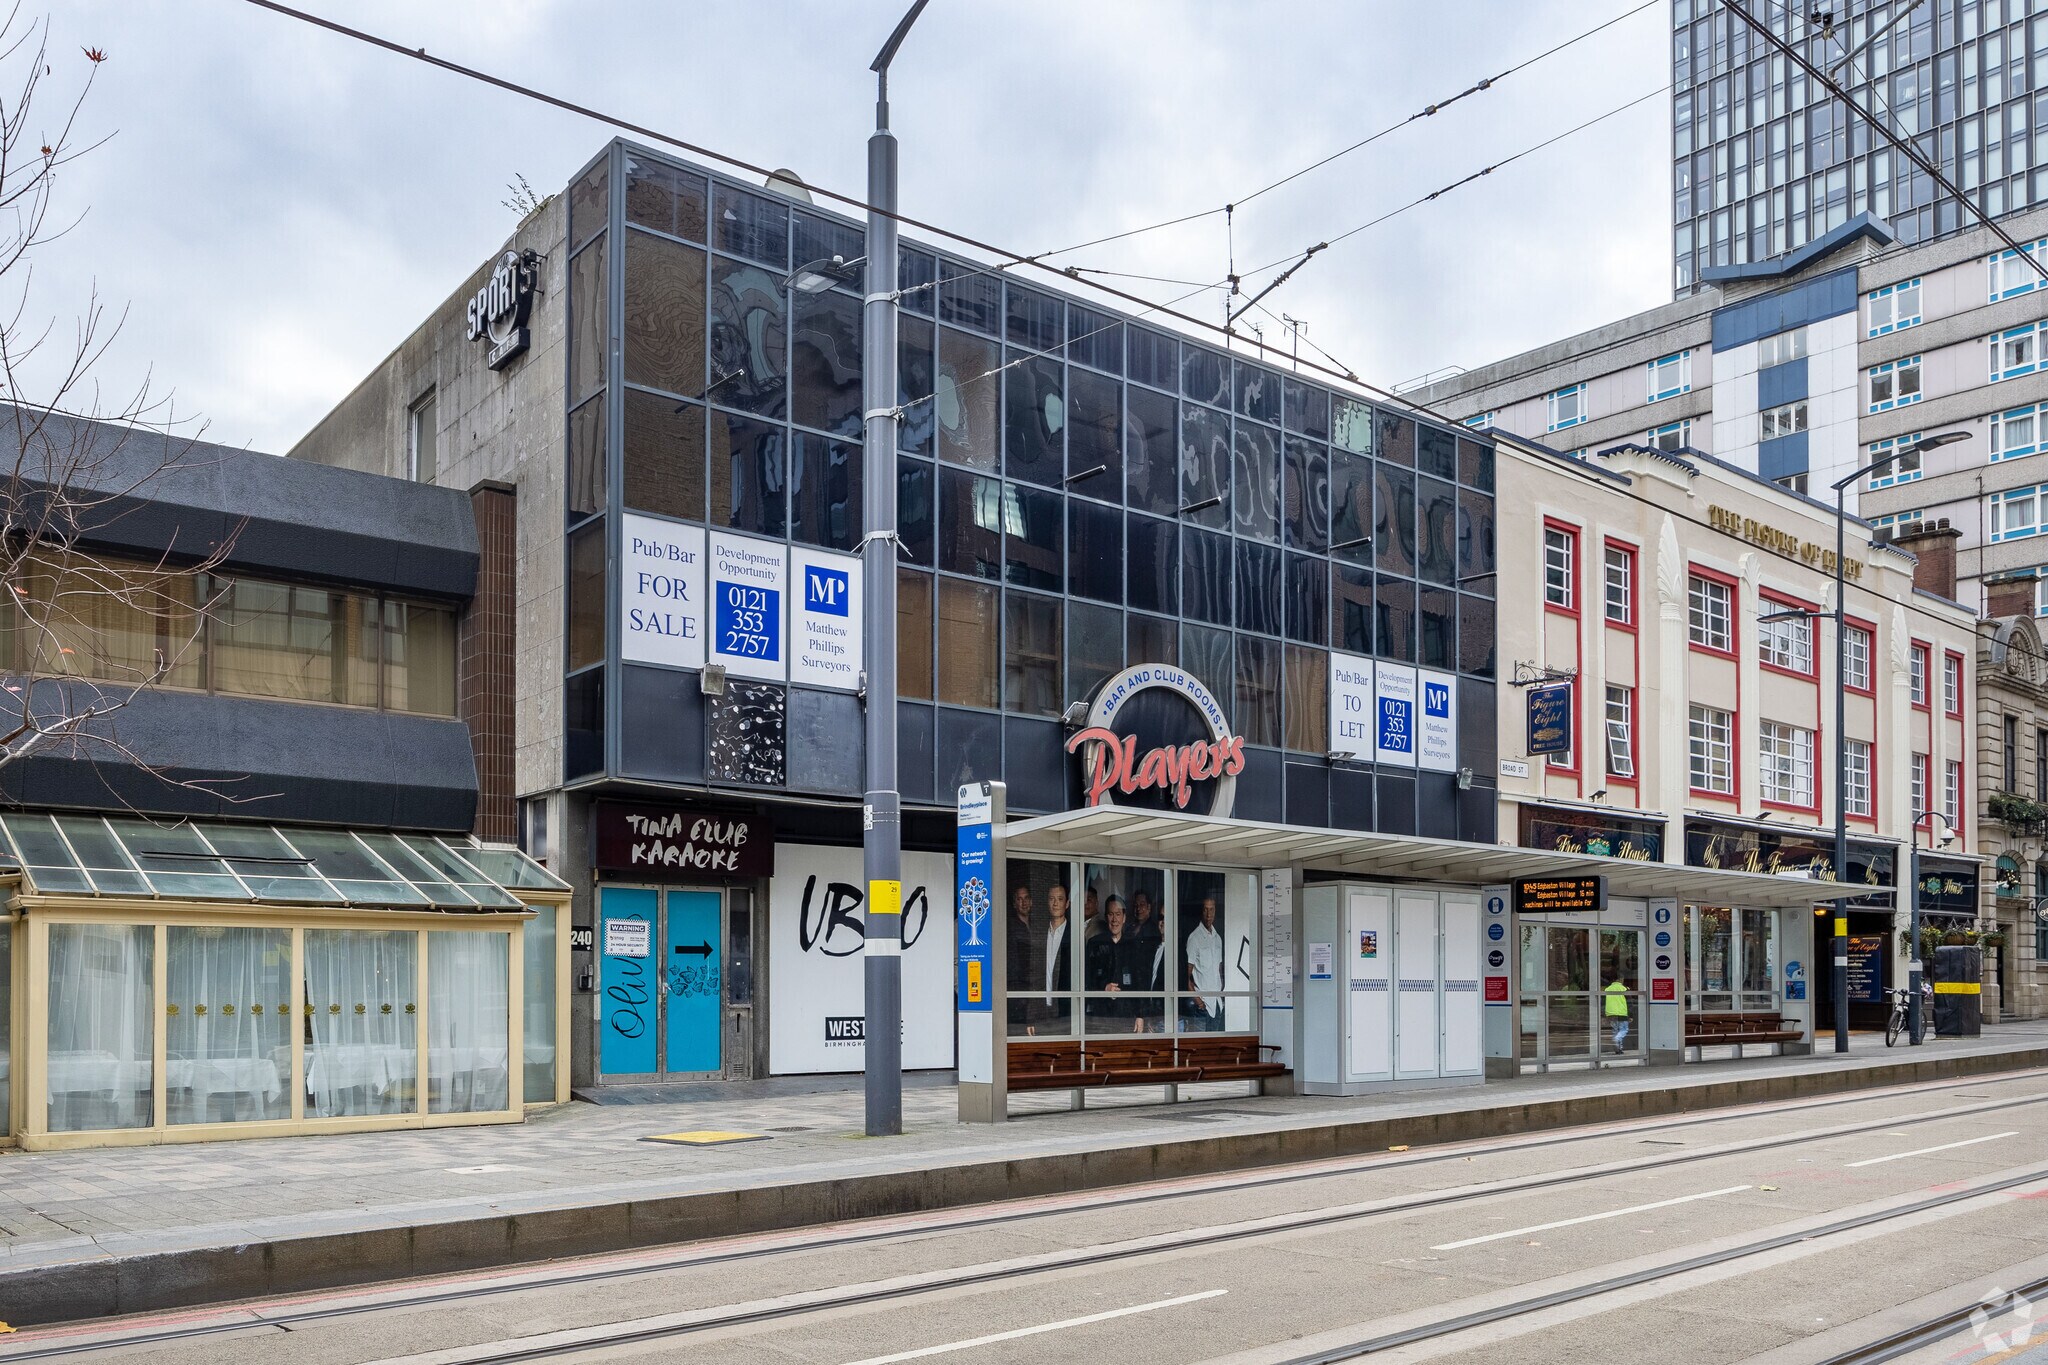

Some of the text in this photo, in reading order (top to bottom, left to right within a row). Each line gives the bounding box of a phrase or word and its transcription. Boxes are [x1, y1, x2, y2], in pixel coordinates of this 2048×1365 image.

[1708, 504, 1741, 532] THE
[1744, 518, 1798, 553] FIGURE
[1800, 541, 1821, 563] OF
[632, 537, 696, 564] Pub/Bar
[716, 544, 780, 567] Development
[719, 560, 777, 583] Opportunity
[637, 572, 690, 602] FOR
[729, 587, 767, 612] 0121
[630, 609, 697, 639] SALE
[732, 609, 763, 633] 353
[806, 620, 848, 637] Matthew
[726, 631, 769, 656] 2757
[809, 638, 845, 655] Phillips
[802, 655, 851, 673] Surveyors
[1335, 669, 1368, 686] Pub/Bar
[1378, 670, 1412, 685] Development
[1105, 669, 1221, 725] BAR AND CLUB ROOMS
[1380, 682, 1410, 696] Opportunity
[1343, 695, 1361, 712] TO
[1385, 700, 1405, 717] 0121
[1531, 699, 1565, 712] Figure
[1387, 717, 1404, 733] 353
[1425, 722, 1448, 733] Matthew
[1534, 711, 1562, 727] Eight
[1340, 720, 1365, 739] LET
[1384, 733, 1407, 749] 2757
[1427, 735, 1447, 747] Phillips
[1424, 748, 1450, 760] Surveyors
[1064, 726, 1245, 808] Players
[1502, 764, 1516, 772] BROAD
[626, 813, 748, 847] TINA CLUB
[631, 840, 740, 871] KARAOKE
[1556, 834, 1650, 861] Free House
[1537, 882, 1558, 890] Edgbaston
[1559, 881, 1576, 889] Village
[1537, 891, 1558, 899] Edgbaston
[1559, 890, 1576, 898] Village
[800, 874, 928, 957] UB0
[611, 924, 645, 932] WARNING
[571, 930, 592, 945] 240
